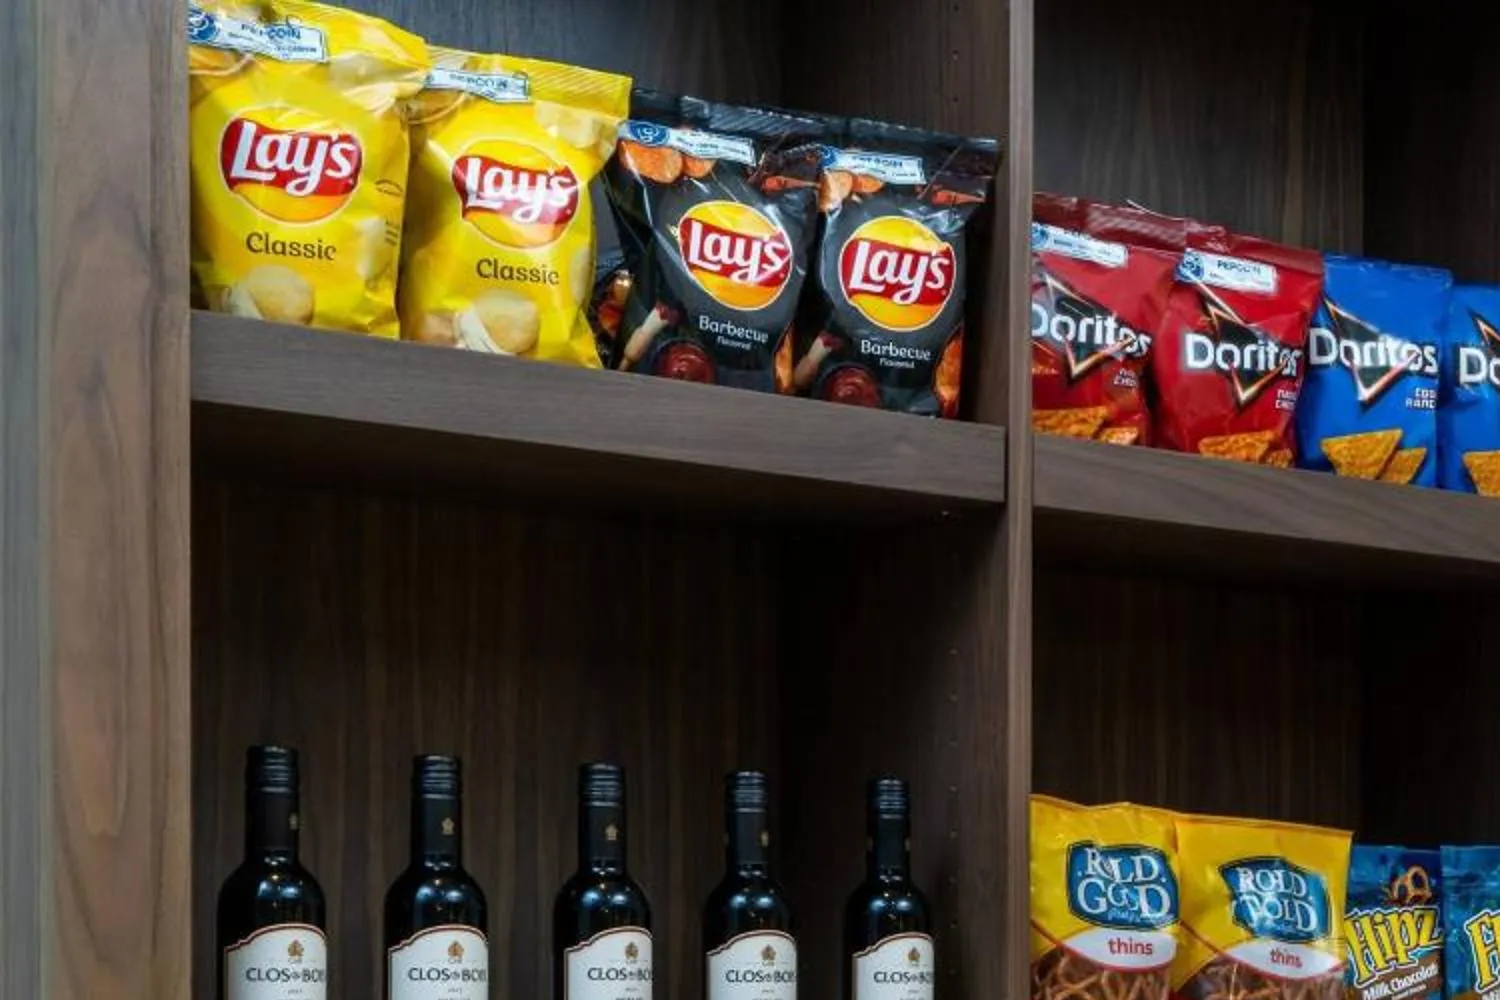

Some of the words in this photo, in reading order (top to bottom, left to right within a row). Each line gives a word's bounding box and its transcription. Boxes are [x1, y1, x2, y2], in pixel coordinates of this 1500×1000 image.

[231, 120, 357, 197] Lay's
[463, 157, 578, 223] Lay's
[245, 232, 336, 261] Classic
[687, 221, 790, 284] Lay's
[476, 258, 560, 286] Classic
[850, 241, 951, 305] Lay's
[698, 315, 770, 343] Barbecue
[861, 340, 931, 361] Barbecue
[1309, 327, 1439, 375] Doritos
[1108, 938, 1153, 957] thins
[1270, 949, 1303, 969] thins
[246, 967, 290, 982] CLOS
[408, 967, 451, 981] CLOS
[587, 967, 627, 981] CLOS
[725, 969, 764, 983] CLOS
[873, 971, 911, 984] CLOS
